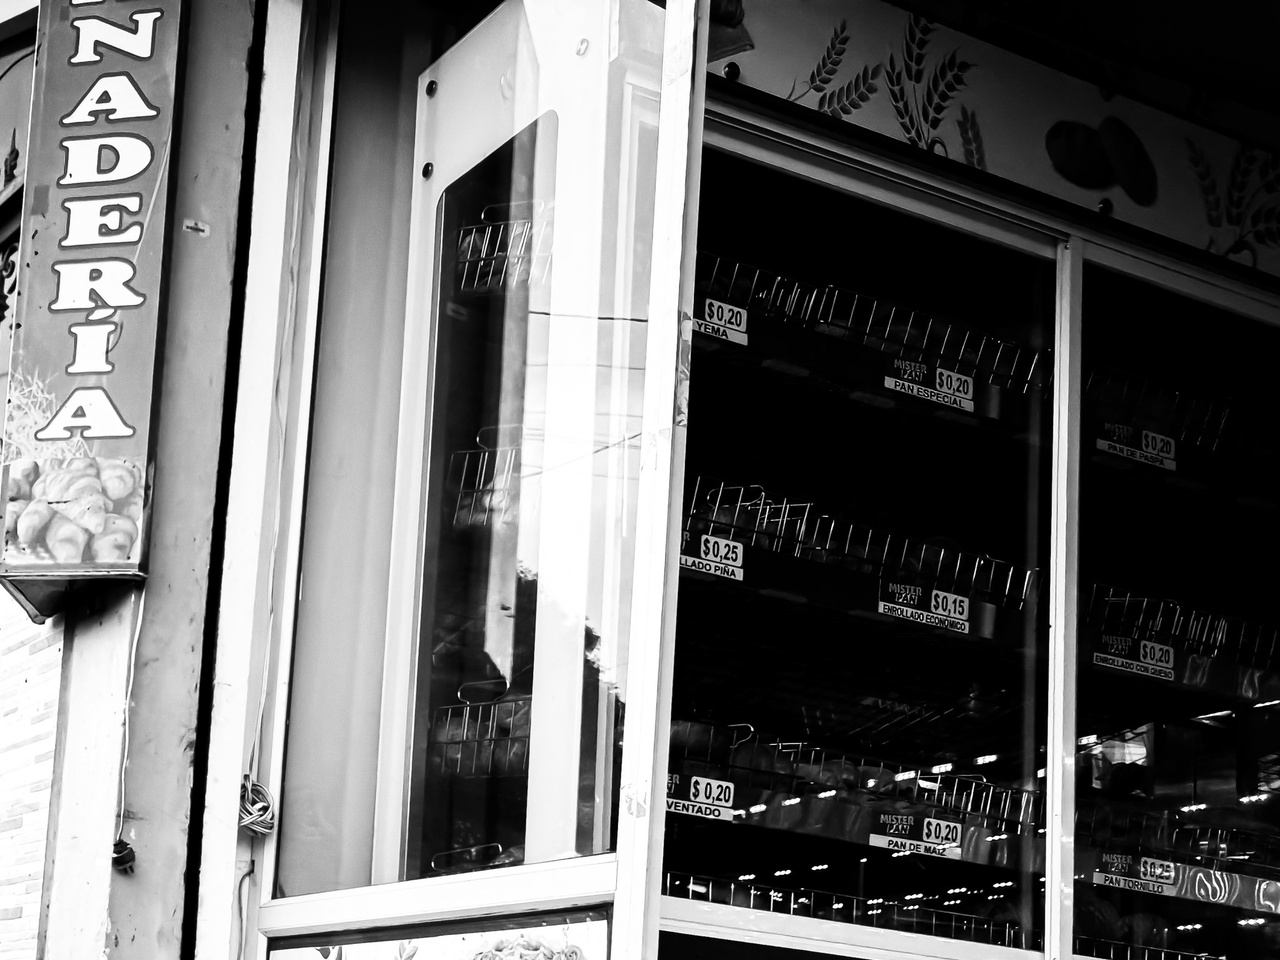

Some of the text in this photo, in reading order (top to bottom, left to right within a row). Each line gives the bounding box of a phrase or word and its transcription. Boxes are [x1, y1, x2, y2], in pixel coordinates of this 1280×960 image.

[35, 0, 164, 441] NADERÍA
[707, 301, 743, 328] $0,20
[696, 320, 729, 339] YEMA
[893, 359, 927, 374] MISTER
[937, 371, 969, 395] $0,20
[894, 380, 965, 409] PAN ESPECIAL
[1107, 443, 1126, 456] PAN
[1126, 448, 1138, 459] DE
[1144, 433, 1172, 456] $0,20
[702, 537, 738, 563] $0,25
[714, 565, 737, 579] PIÑA
[888, 582, 923, 596] MISTER
[883, 603, 925, 622] ENROLLADO
[933, 593, 965, 616] $0,15
[1142, 643, 1171, 665] $0,20
[880, 814, 914, 826] MISTER
[925, 820, 958, 843] $0,20
[888, 839, 907, 850] PAN
[908, 843, 922, 853] DE
[1104, 874, 1121, 887] PAN
